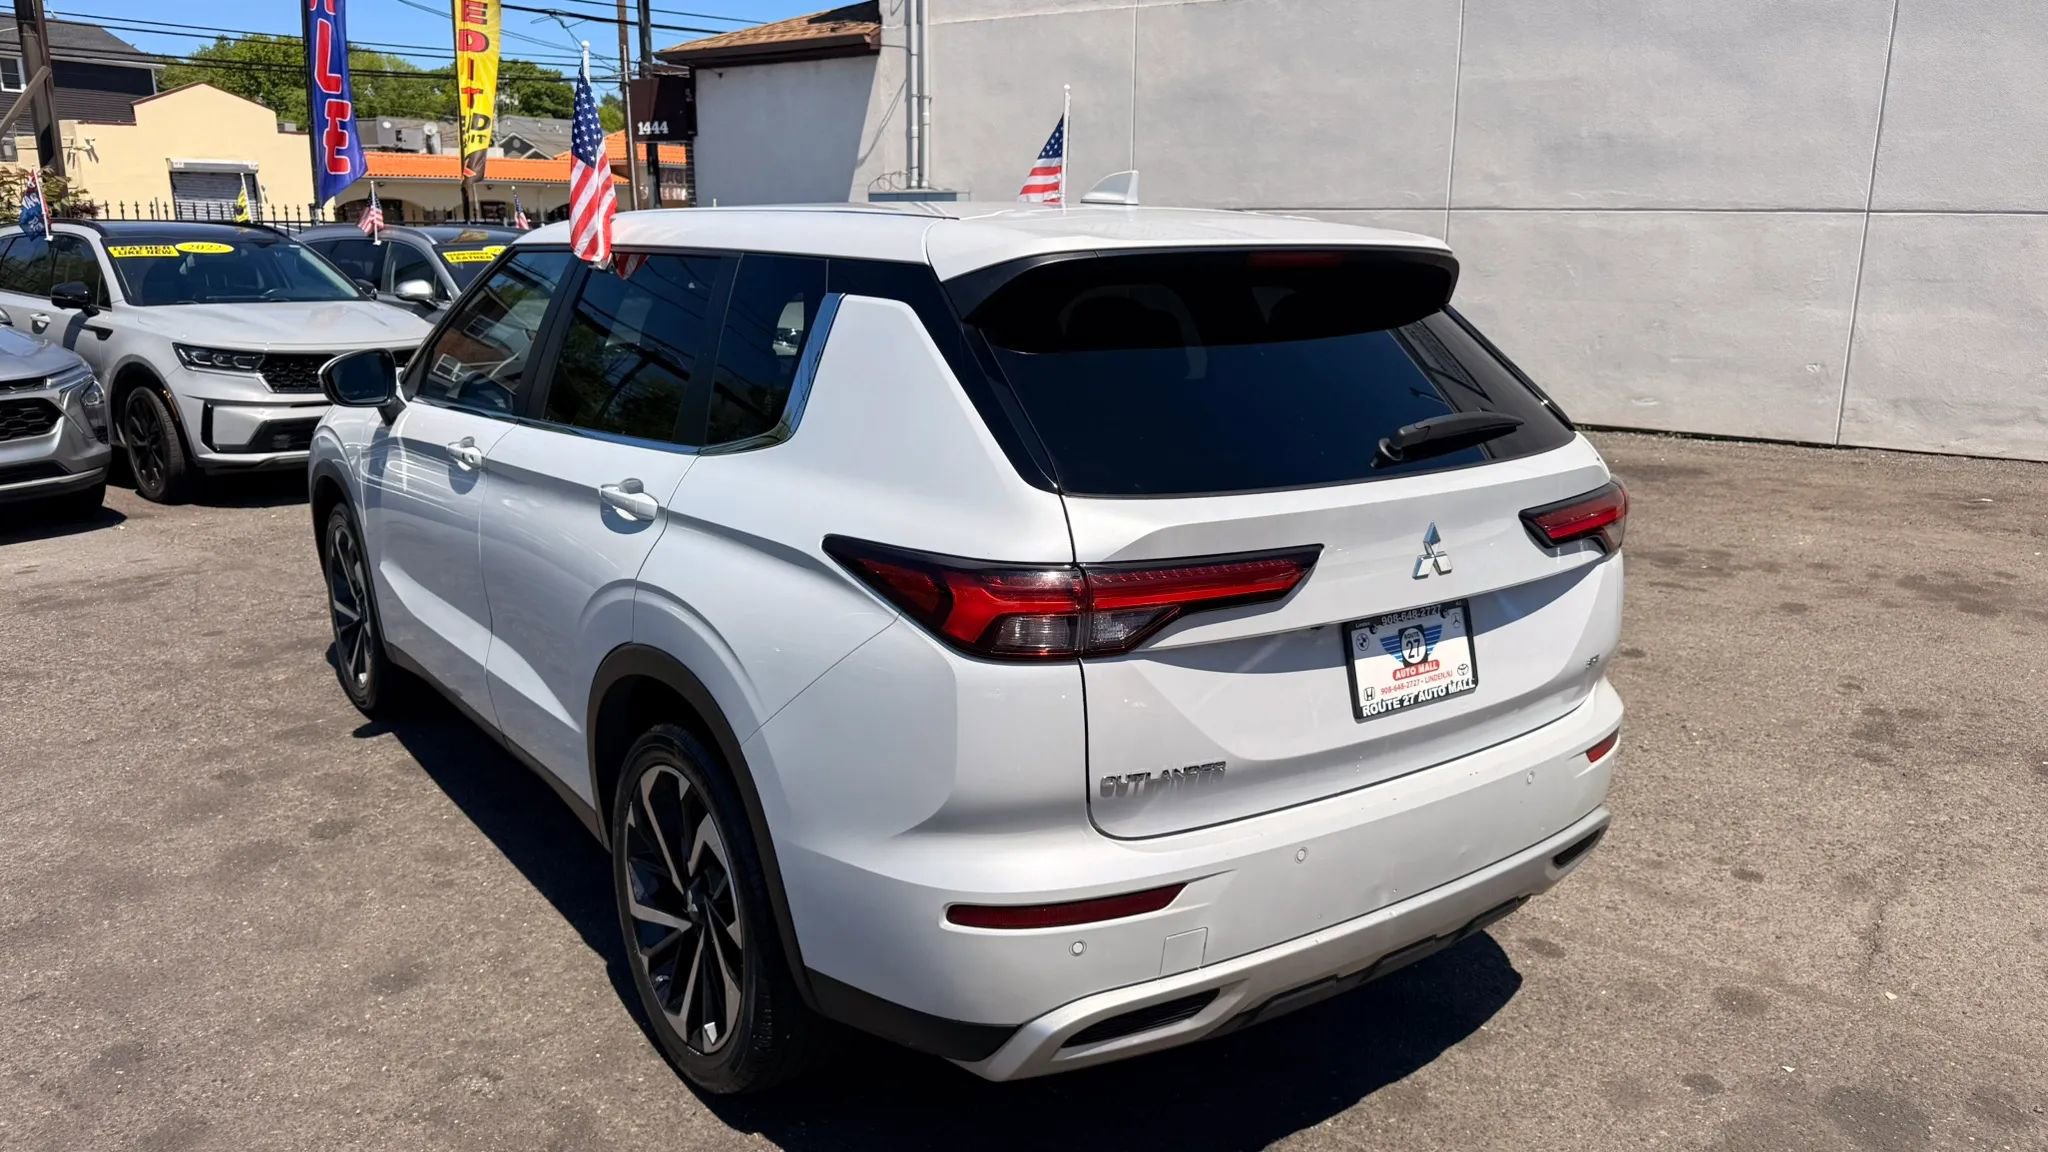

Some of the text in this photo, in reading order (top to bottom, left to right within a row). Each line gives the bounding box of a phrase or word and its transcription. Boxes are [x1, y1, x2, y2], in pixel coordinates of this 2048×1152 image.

[305, 0, 352, 174] LE
[637, 121, 669, 135] 1444
[1381, 606, 1441, 625] 908-648-2727
[1405, 639, 1421, 660] 27
[1395, 661, 1439, 679] AUTO MALL
[1362, 678, 1476, 717] ROUTE 27 AUTO MALL
[1380, 680, 1420, 695] 908-648-2727
[1100, 761, 1226, 798] OUTLANDER
